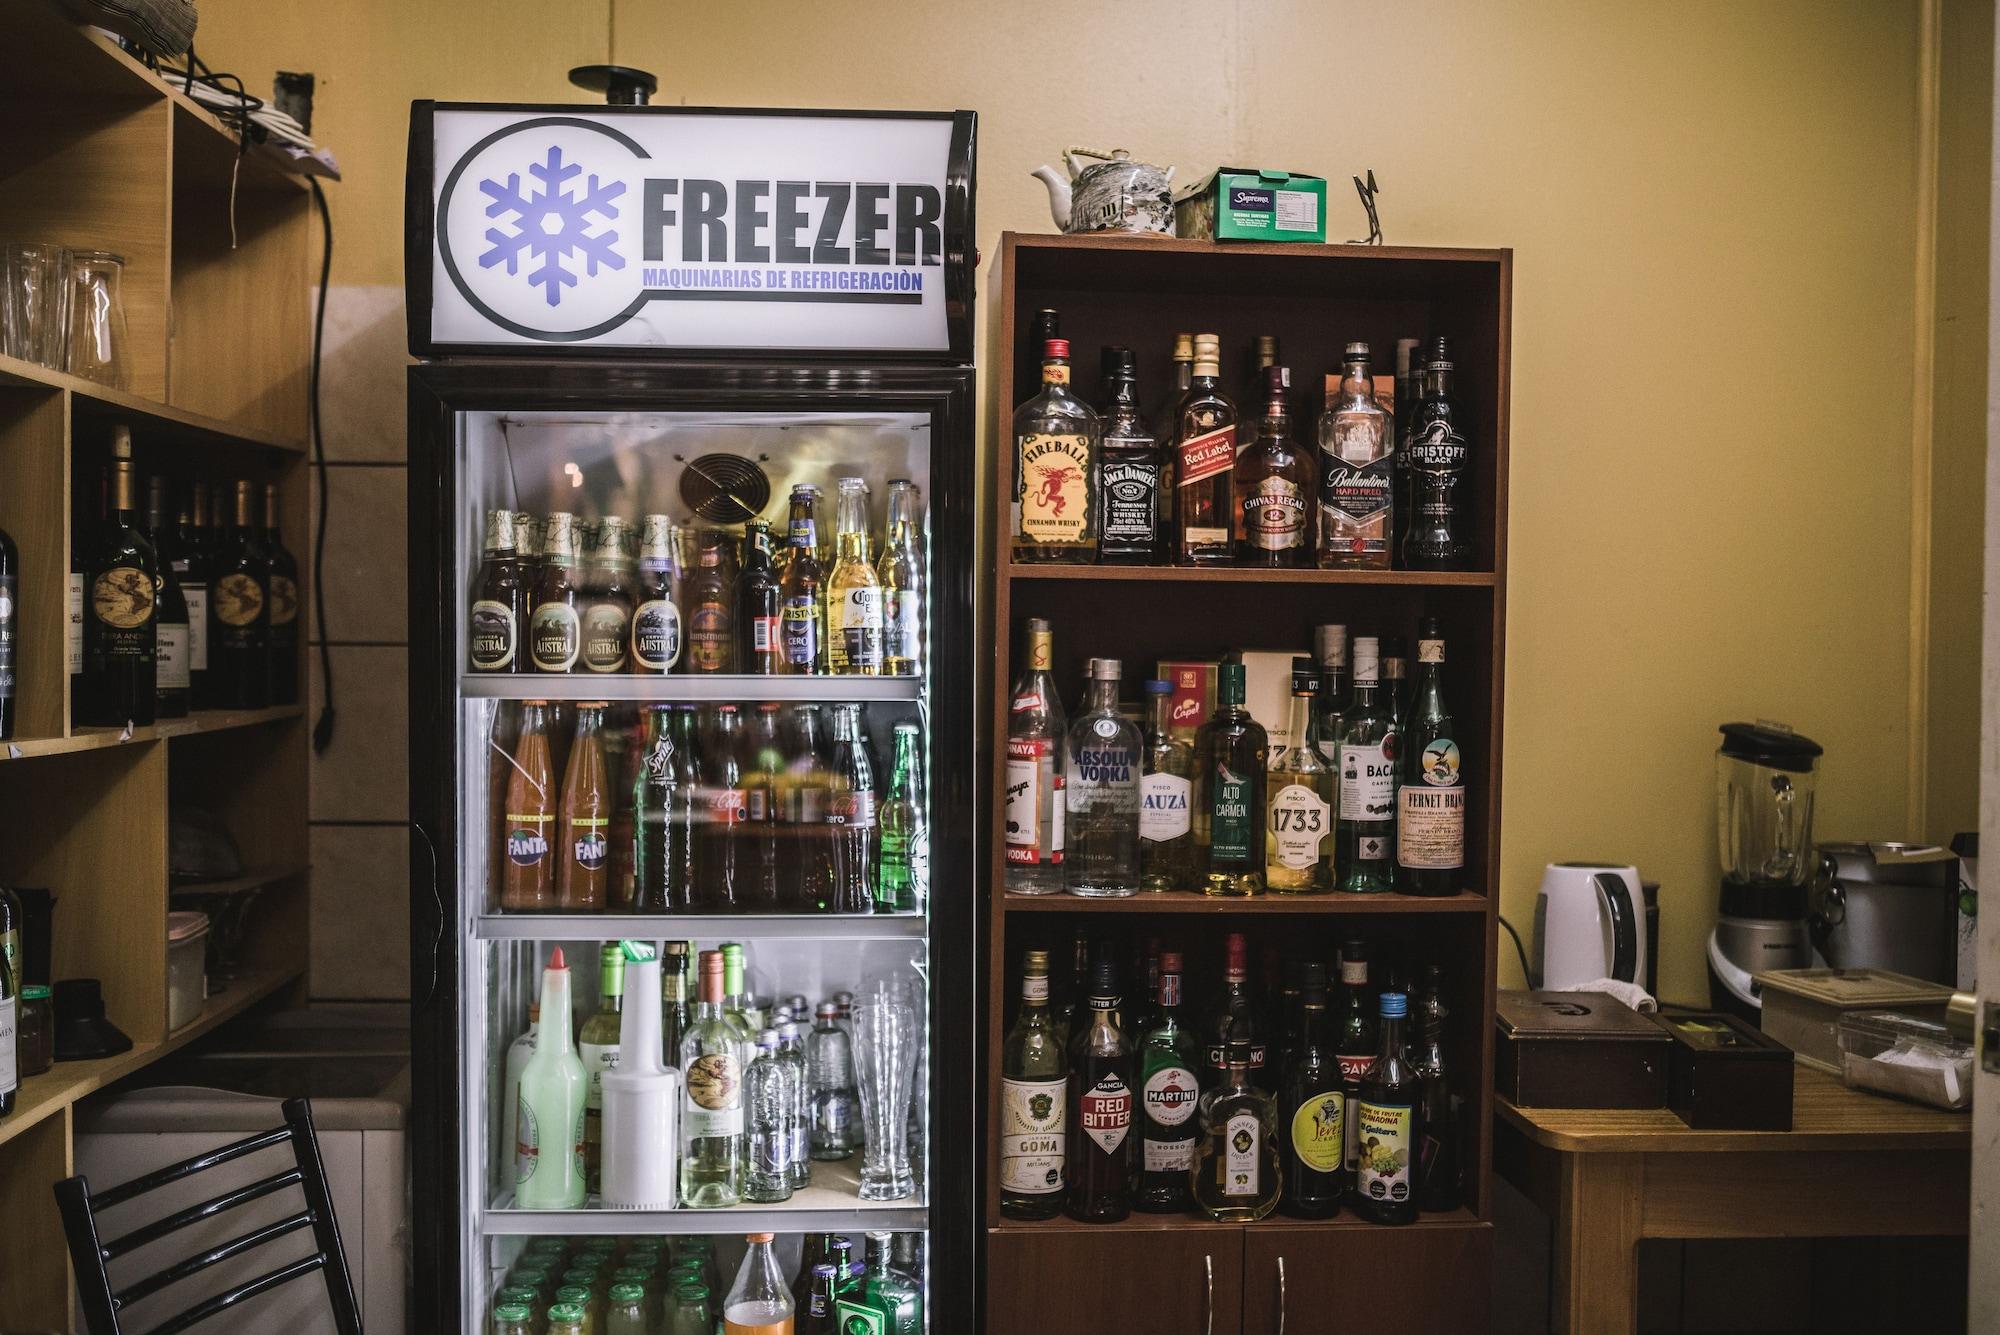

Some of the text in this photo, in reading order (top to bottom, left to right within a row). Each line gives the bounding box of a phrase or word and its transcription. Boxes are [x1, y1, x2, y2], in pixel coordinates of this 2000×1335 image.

[1234, 191, 1270, 204] Supremo
[642, 178, 942, 267] FREEZER
[642, 267, 762, 289] MAQUINARIAS
[766, 269, 786, 289] DE
[1024, 440, 1086, 465] FIREBALL
[1183, 440, 1233, 466] Red Label
[1411, 445, 1465, 458] ERISTOFF
[1424, 456, 1452, 464] BLACK
[1103, 465, 1156, 489] JACK DANIEL'S
[1326, 467, 1391, 489] Ballantine's
[1335, 487, 1382, 496] HARD FIRED
[1111, 499, 1147, 509] Tennessee
[1244, 495, 1304, 511] CHIVAS REGAL
[1112, 511, 1147, 519] WHISKEY
[1269, 510, 1280, 520] 12
[473, 636, 507, 651] AUSTRAL
[535, 638, 573, 653] AUSTRAL
[587, 640, 623, 655] AUSTRAL
[639, 636, 676, 651] AUSTRAL
[788, 636, 808, 646] CERO
[1173, 701, 1200, 720] Capel
[648, 740, 672, 774] Sprite
[1080, 766, 1130, 782] VODKA
[1222, 786, 1240, 799] ALTO
[1408, 793, 1442, 808] FERNET
[1215, 803, 1246, 817] CARMEN
[1273, 808, 1321, 832] 1733
[507, 836, 548, 856] FANTA
[1210, 1050, 1263, 1063] CINO
[1149, 1090, 1195, 1103] MARTINI
[1095, 1098, 1124, 1113] RED
[1083, 1110, 1131, 1127] BITTER
[1020, 1140, 1057, 1152] GOMA
